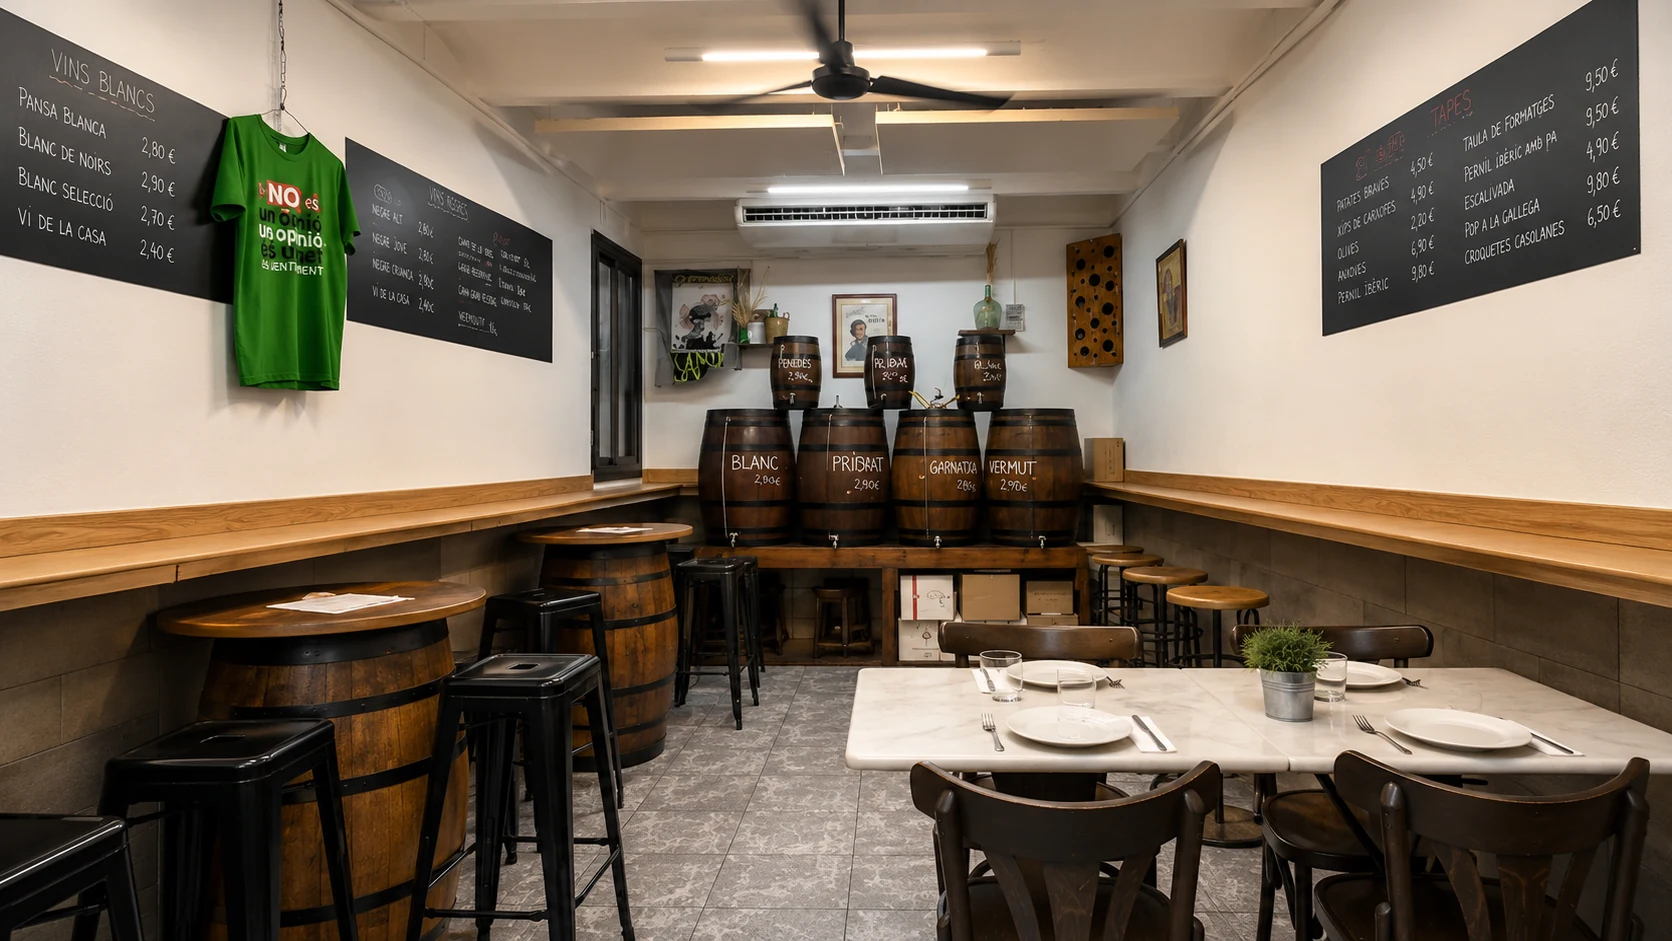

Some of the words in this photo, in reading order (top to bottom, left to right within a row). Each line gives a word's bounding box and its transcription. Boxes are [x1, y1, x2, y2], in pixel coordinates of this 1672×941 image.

[51, 48, 90, 85] VINS
[99, 70, 156, 113] BLANCS
[18, 86, 58, 120] PANSA
[63, 106, 107, 139] BLANCA
[141, 136, 165, 159] 2,80
[1430, 88, 1471, 128] TAPES
[1462, 128, 1489, 152] TAULA
[1490, 121, 1502, 139] DE
[1504, 93, 1556, 132] FORMATGES
[1585, 65, 1609, 93] 9,50
[1545, 130, 1558, 152] PA
[1585, 102, 1610, 129] 9,50
[18, 126, 57, 157] BLANC
[61, 145, 75, 163] DE
[141, 171, 165, 193] 2,90
[1410, 156, 1427, 178] 4,50
[1586, 137, 1610, 163] 4,90
[18, 166, 57, 196] BLANC
[62, 182, 114, 212] SELECCIÓ
[140, 205, 164, 227] 2,70
[268, 181, 301, 209] NO
[1352, 216, 1362, 230] DE
[1410, 184, 1427, 206] 4,90
[1481, 218, 1488, 233] A
[1489, 214, 1501, 230] LA
[1502, 197, 1541, 225] GALLEGA
[1586, 171, 1610, 198] 9,80
[38, 213, 54, 233] DE
[59, 219, 73, 238] LA
[77, 224, 107, 247] CASA
[139, 239, 164, 260] 2,40
[1410, 212, 1428, 232] 2,20
[1464, 237, 1512, 266] CROQUETES
[1514, 219, 1566, 250] CASOLANES
[1586, 203, 1611, 229] 6,50
[1410, 238, 1428, 259] 6,90
[1410, 264, 1428, 283] 9,80
[731, 454, 779, 471] BLANC
[989, 460, 1037, 476] VERMUT
